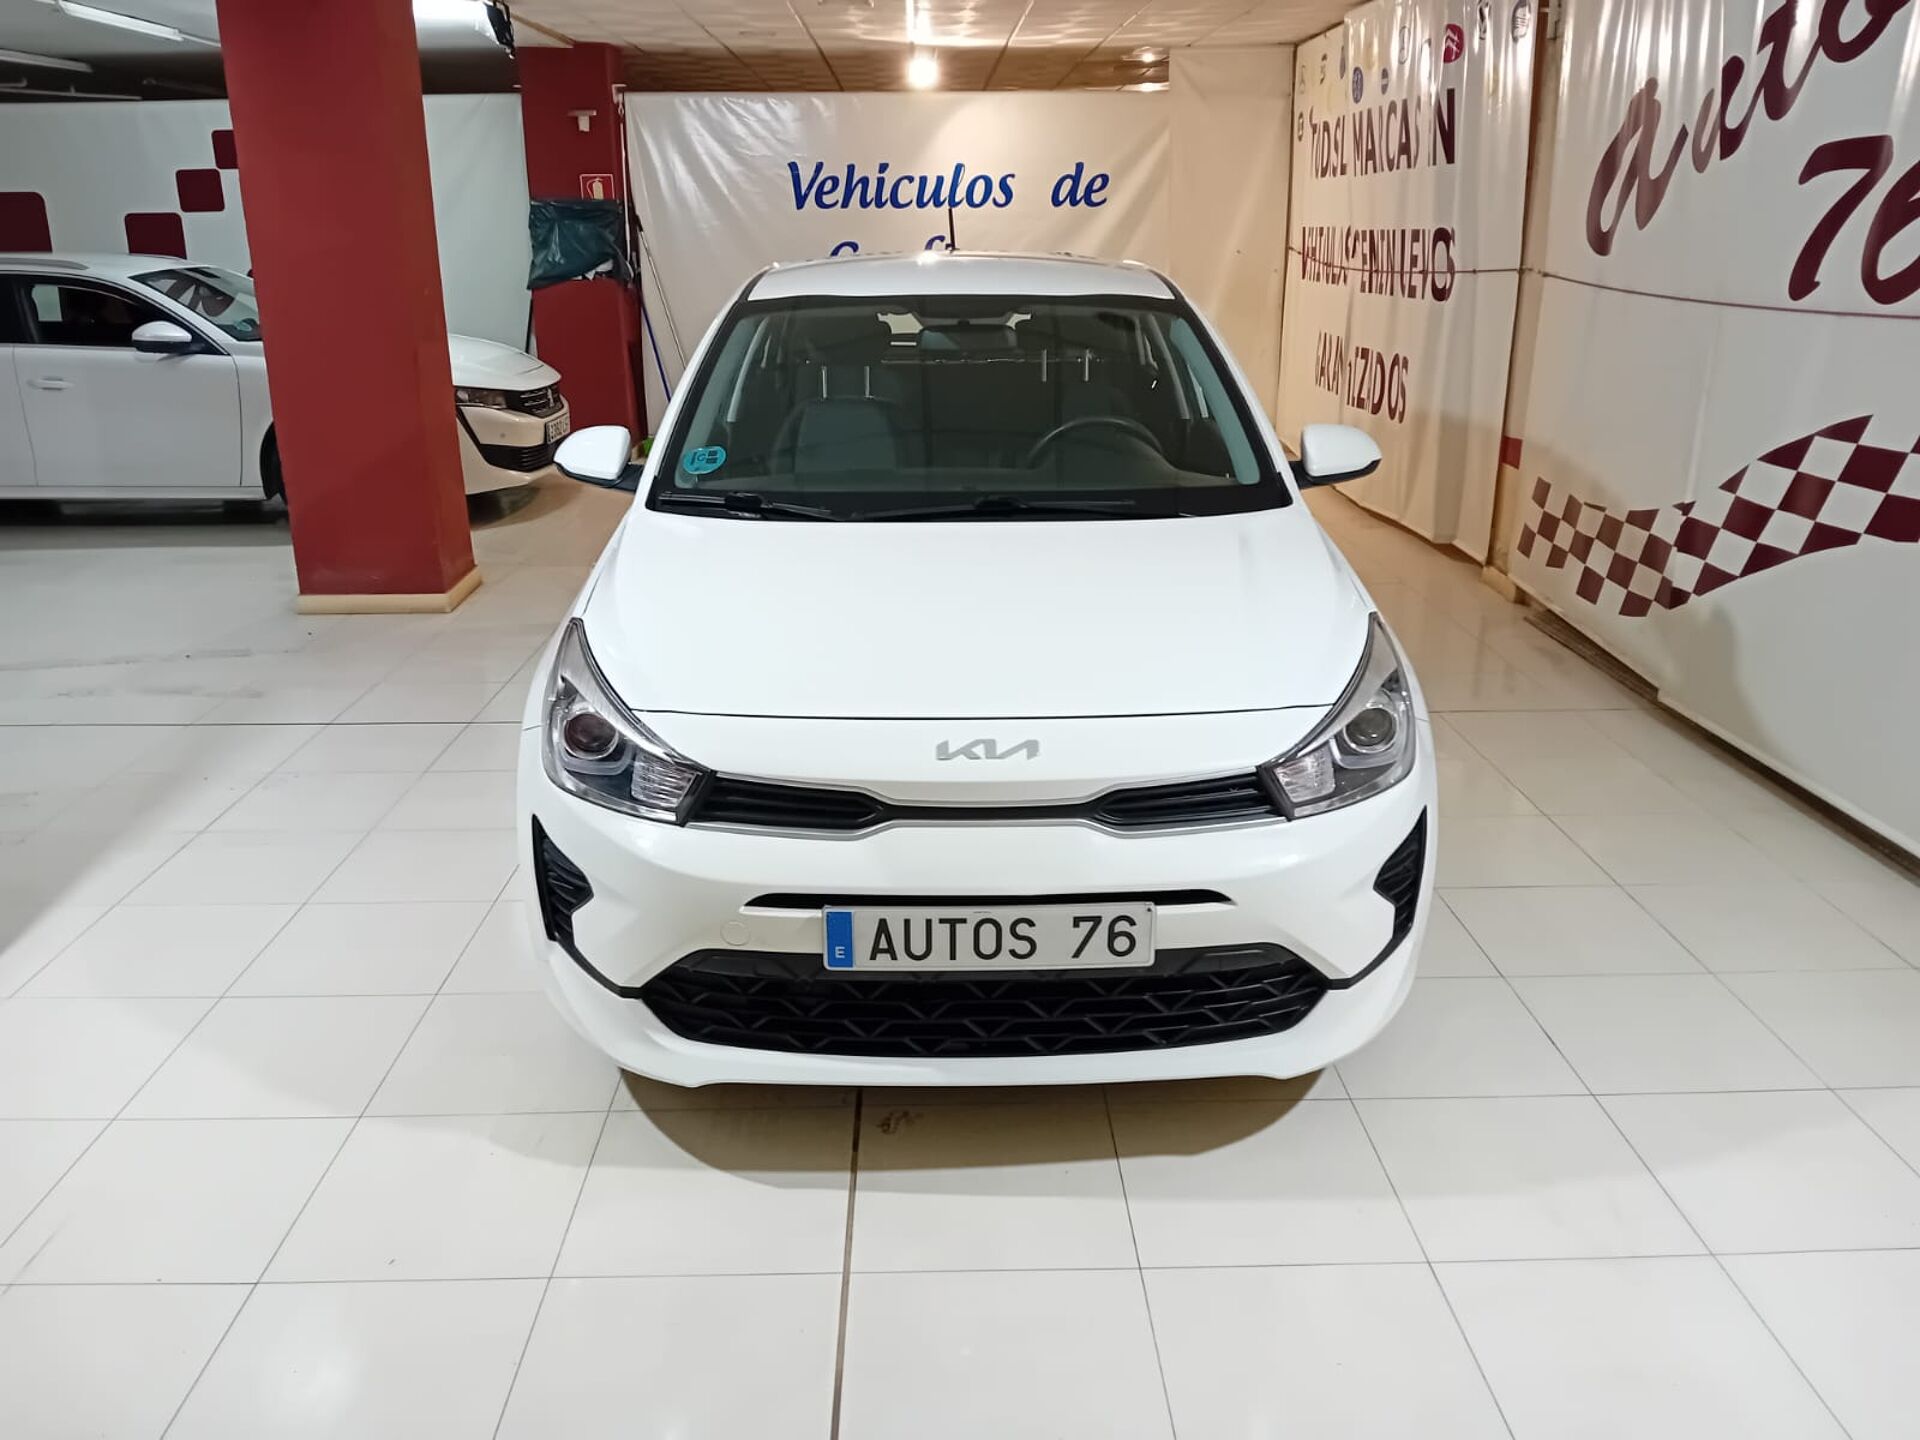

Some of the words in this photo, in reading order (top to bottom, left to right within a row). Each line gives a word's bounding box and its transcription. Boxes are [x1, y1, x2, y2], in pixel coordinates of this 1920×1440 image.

[1051, 162, 1110, 208] de
[936, 739, 1038, 760] KIA
[835, 947, 845, 958] E
[869, 917, 1037, 961] AUTOS
[1071, 915, 1137, 959] 76
